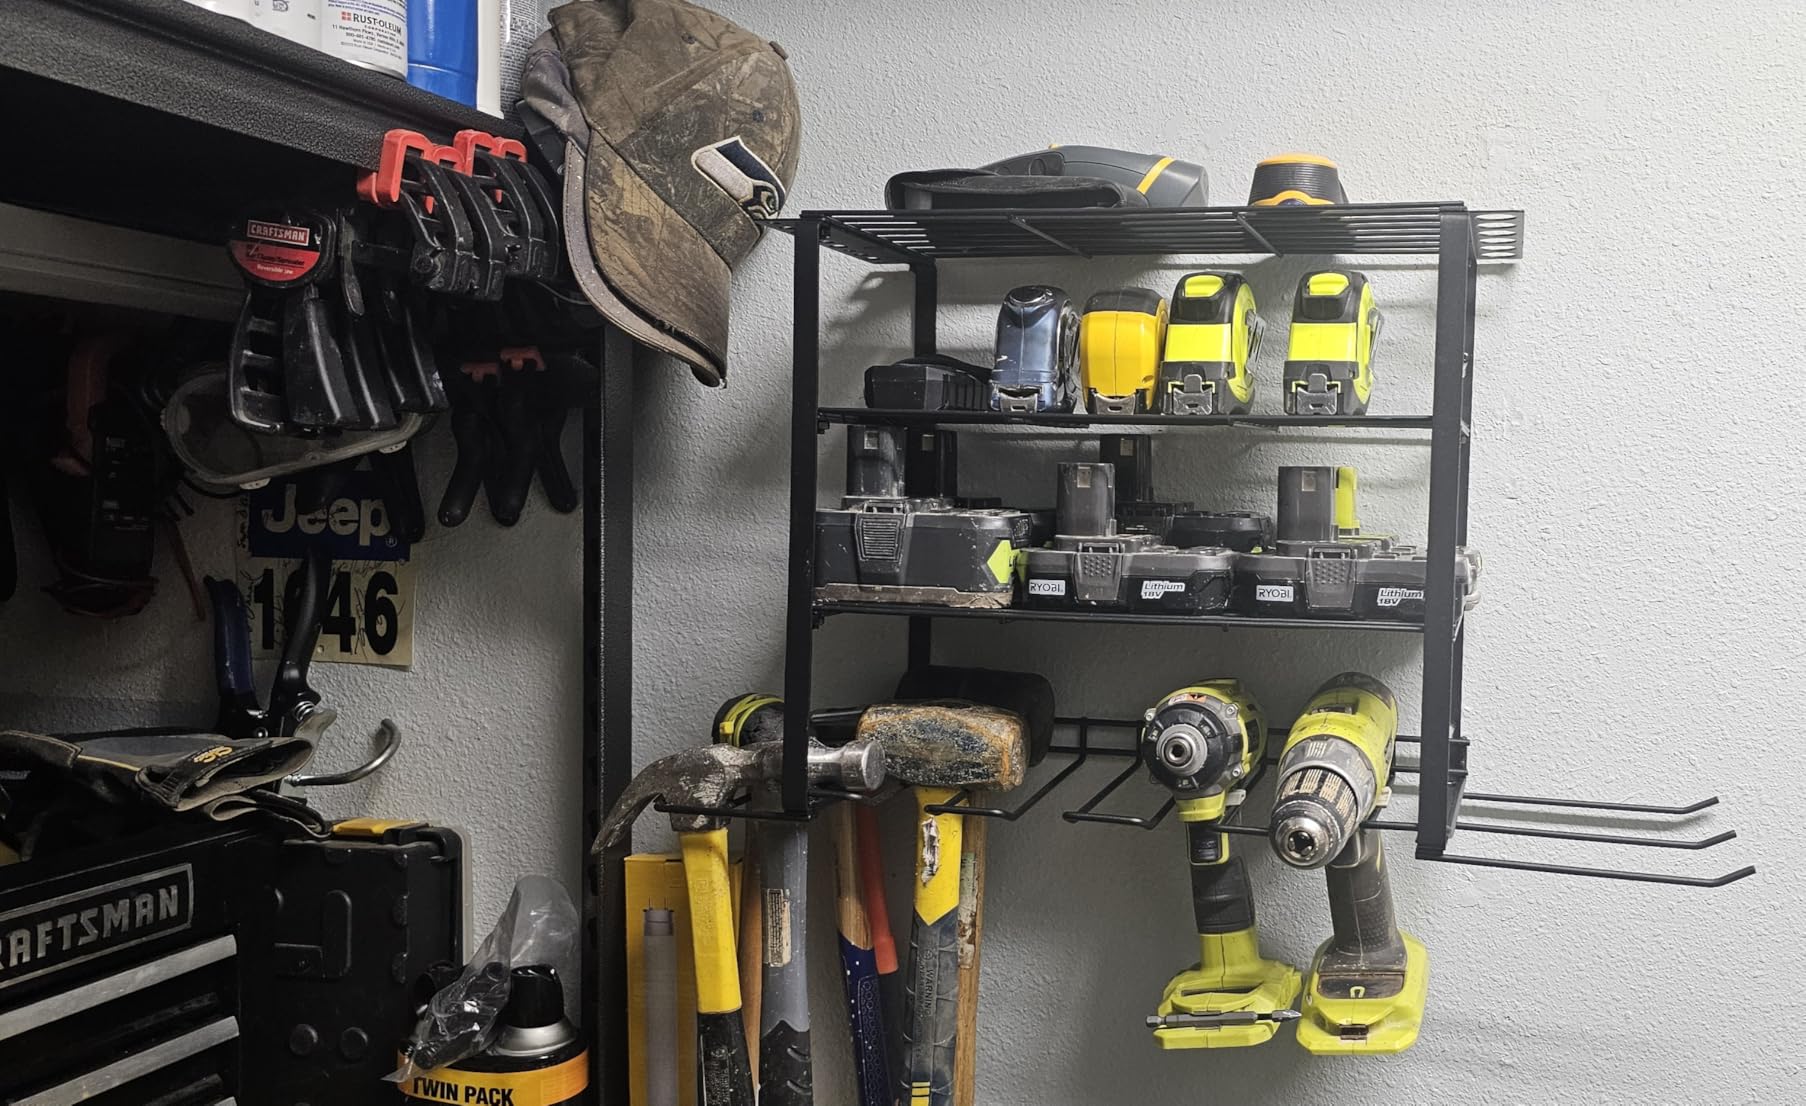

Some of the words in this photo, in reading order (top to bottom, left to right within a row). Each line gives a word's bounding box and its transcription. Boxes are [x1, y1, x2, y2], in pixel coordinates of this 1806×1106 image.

[353, 13, 402, 35] RUST-OLEUM
[250, 223, 306, 242] CRAFTSMAN
[261, 483, 393, 546] Jeep
[1030, 581, 1061, 593] RYOBI
[1144, 582, 1184, 592] Lithium
[1258, 587, 1291, 599] RYOBI
[1380, 589, 1424, 599] Lithium
[1142, 591, 1162, 599] 18V
[1379, 598, 1400, 606] 18V
[0, 885, 179, 971] AFTSMAN
[924, 969, 934, 1016] WARNING
[413, 1077, 458, 1101] TWIN
[464, 1085, 514, 1106] PACK
